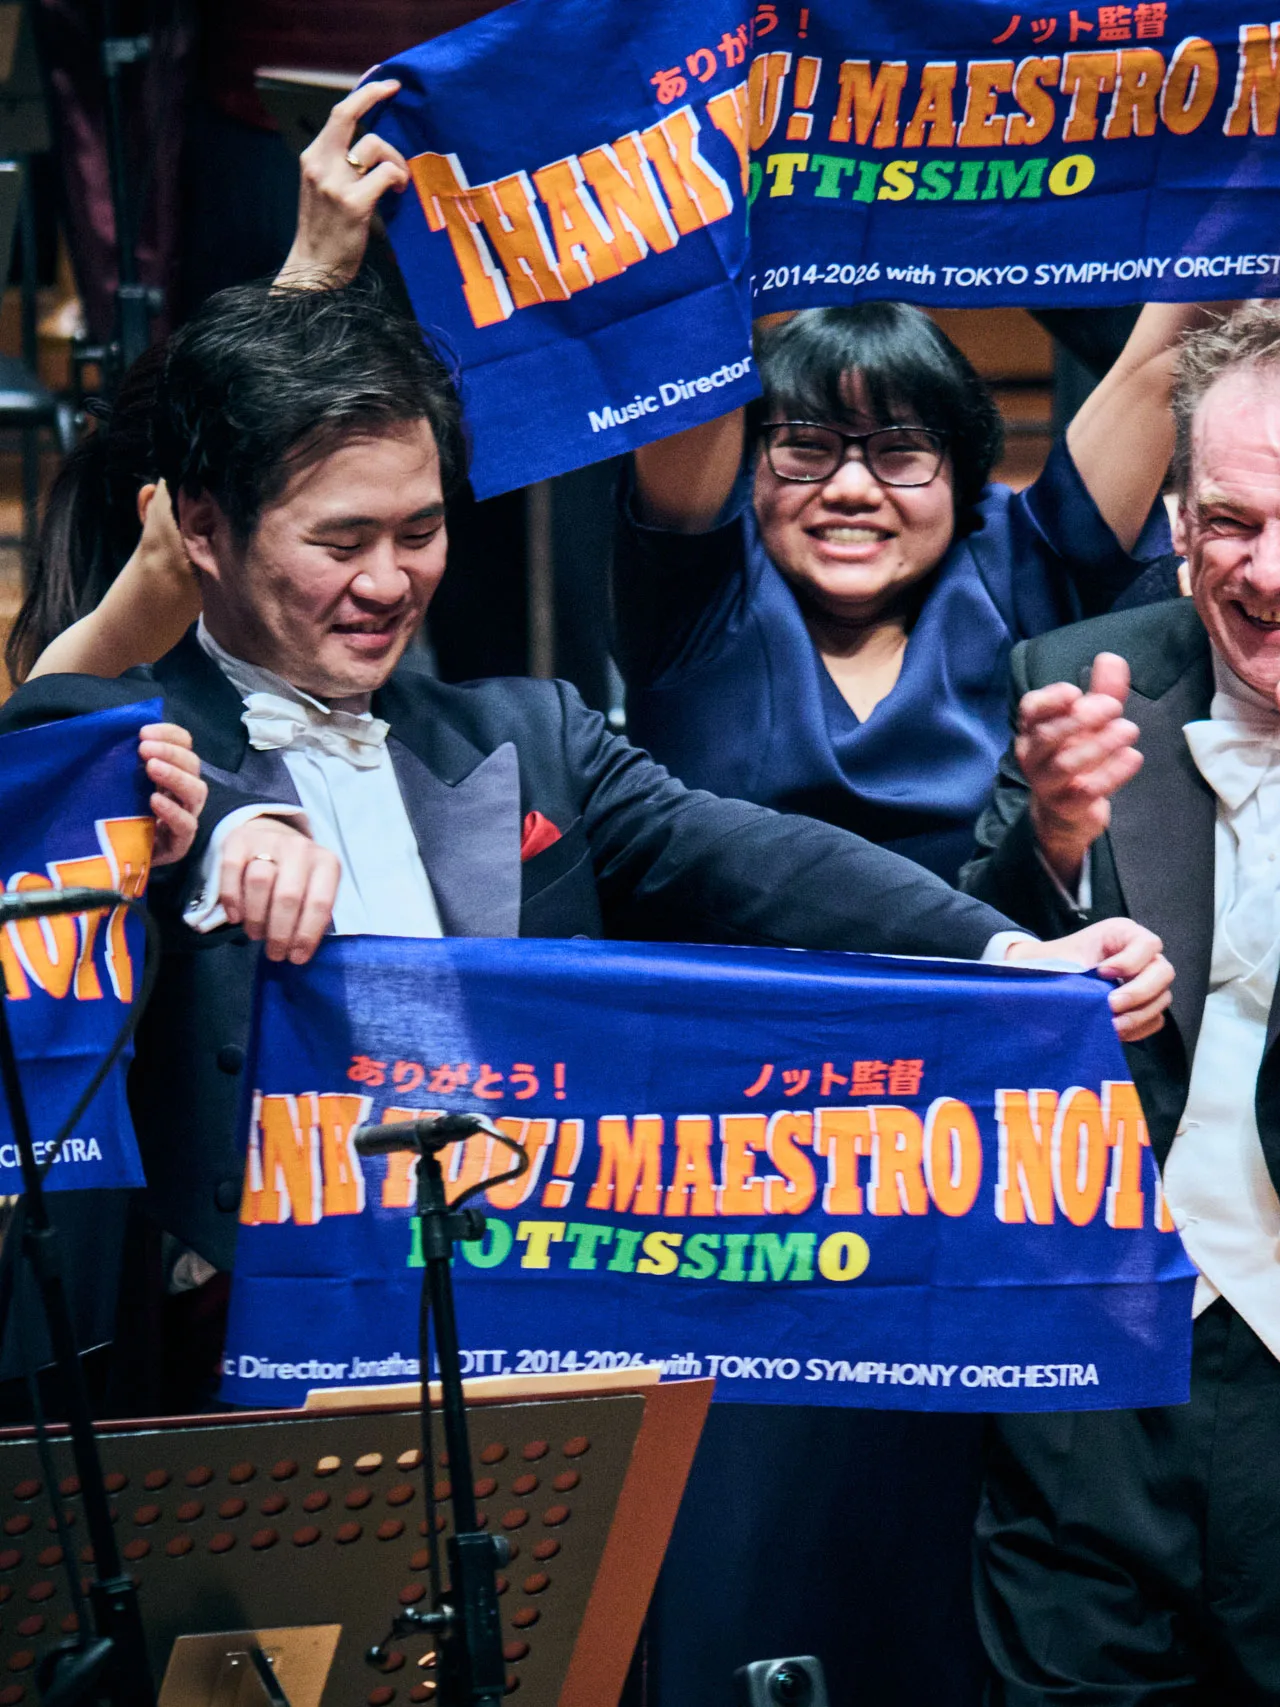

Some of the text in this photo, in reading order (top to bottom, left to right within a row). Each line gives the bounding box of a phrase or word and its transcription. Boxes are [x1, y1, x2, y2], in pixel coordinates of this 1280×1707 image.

[992, 1, 1169, 45] ノット監督
[407, 104, 733, 328] THANK
[829, 36, 1220, 150] MAESTRO
[762, 262, 881, 291] 2014-2026
[886, 263, 936, 287] with
[941, 264, 1027, 288] TOKYO
[1033, 256, 1170, 286] SYMPHONY
[587, 355, 752, 433] Music Director
[743, 1059, 925, 1097] ノット監督
[586, 1096, 984, 1217] MAESTRO
[994, 1080, 1176, 1233] NOT
[238, 1354, 350, 1380] Director
[704, 1354, 801, 1382] TOKYO
[804, 1358, 960, 1388] SYMPHONY
[959, 1363, 1100, 1389] ORCHESTRA
